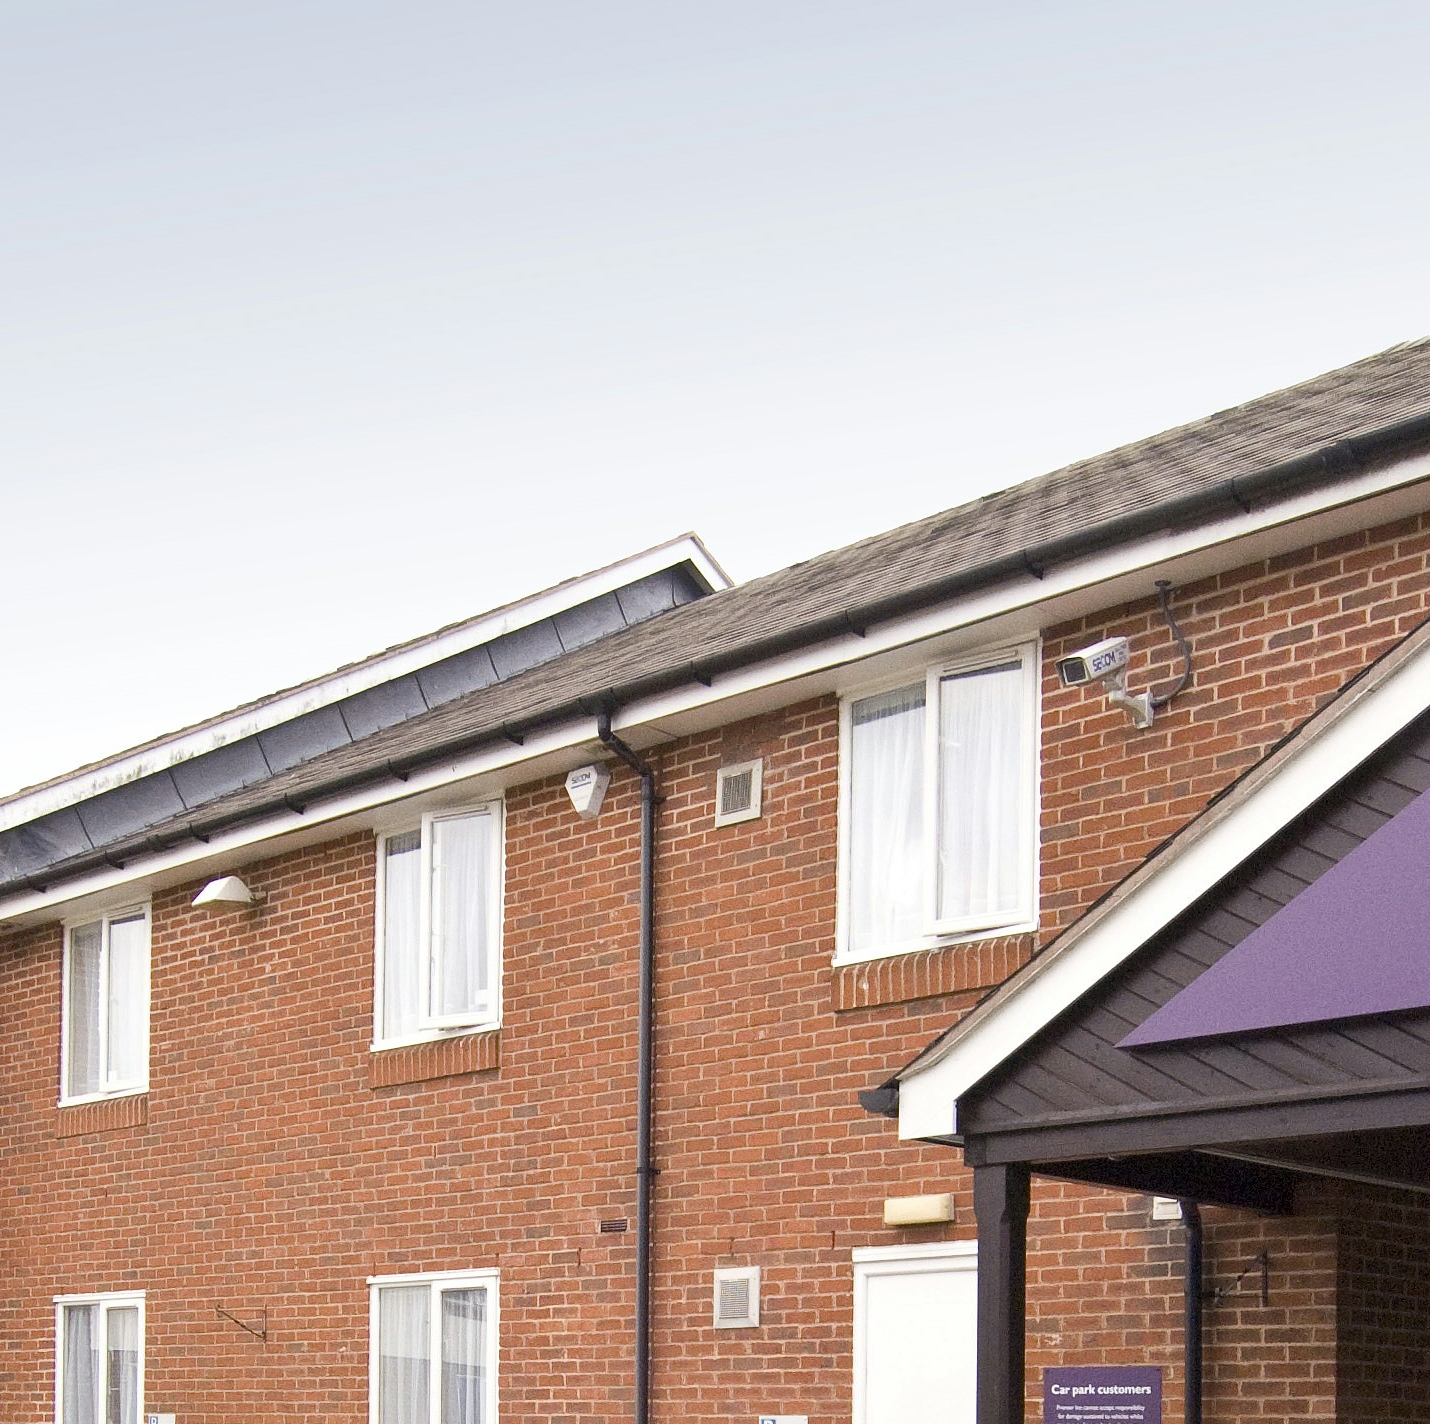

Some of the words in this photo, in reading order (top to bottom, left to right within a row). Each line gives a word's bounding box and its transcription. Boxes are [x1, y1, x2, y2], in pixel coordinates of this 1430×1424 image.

[1092, 651, 1116, 672] SECOM
[1051, 1384, 1070, 1395] Car
[1072, 1384, 1096, 1398] park
[1097, 1385, 1152, 1395] customers
